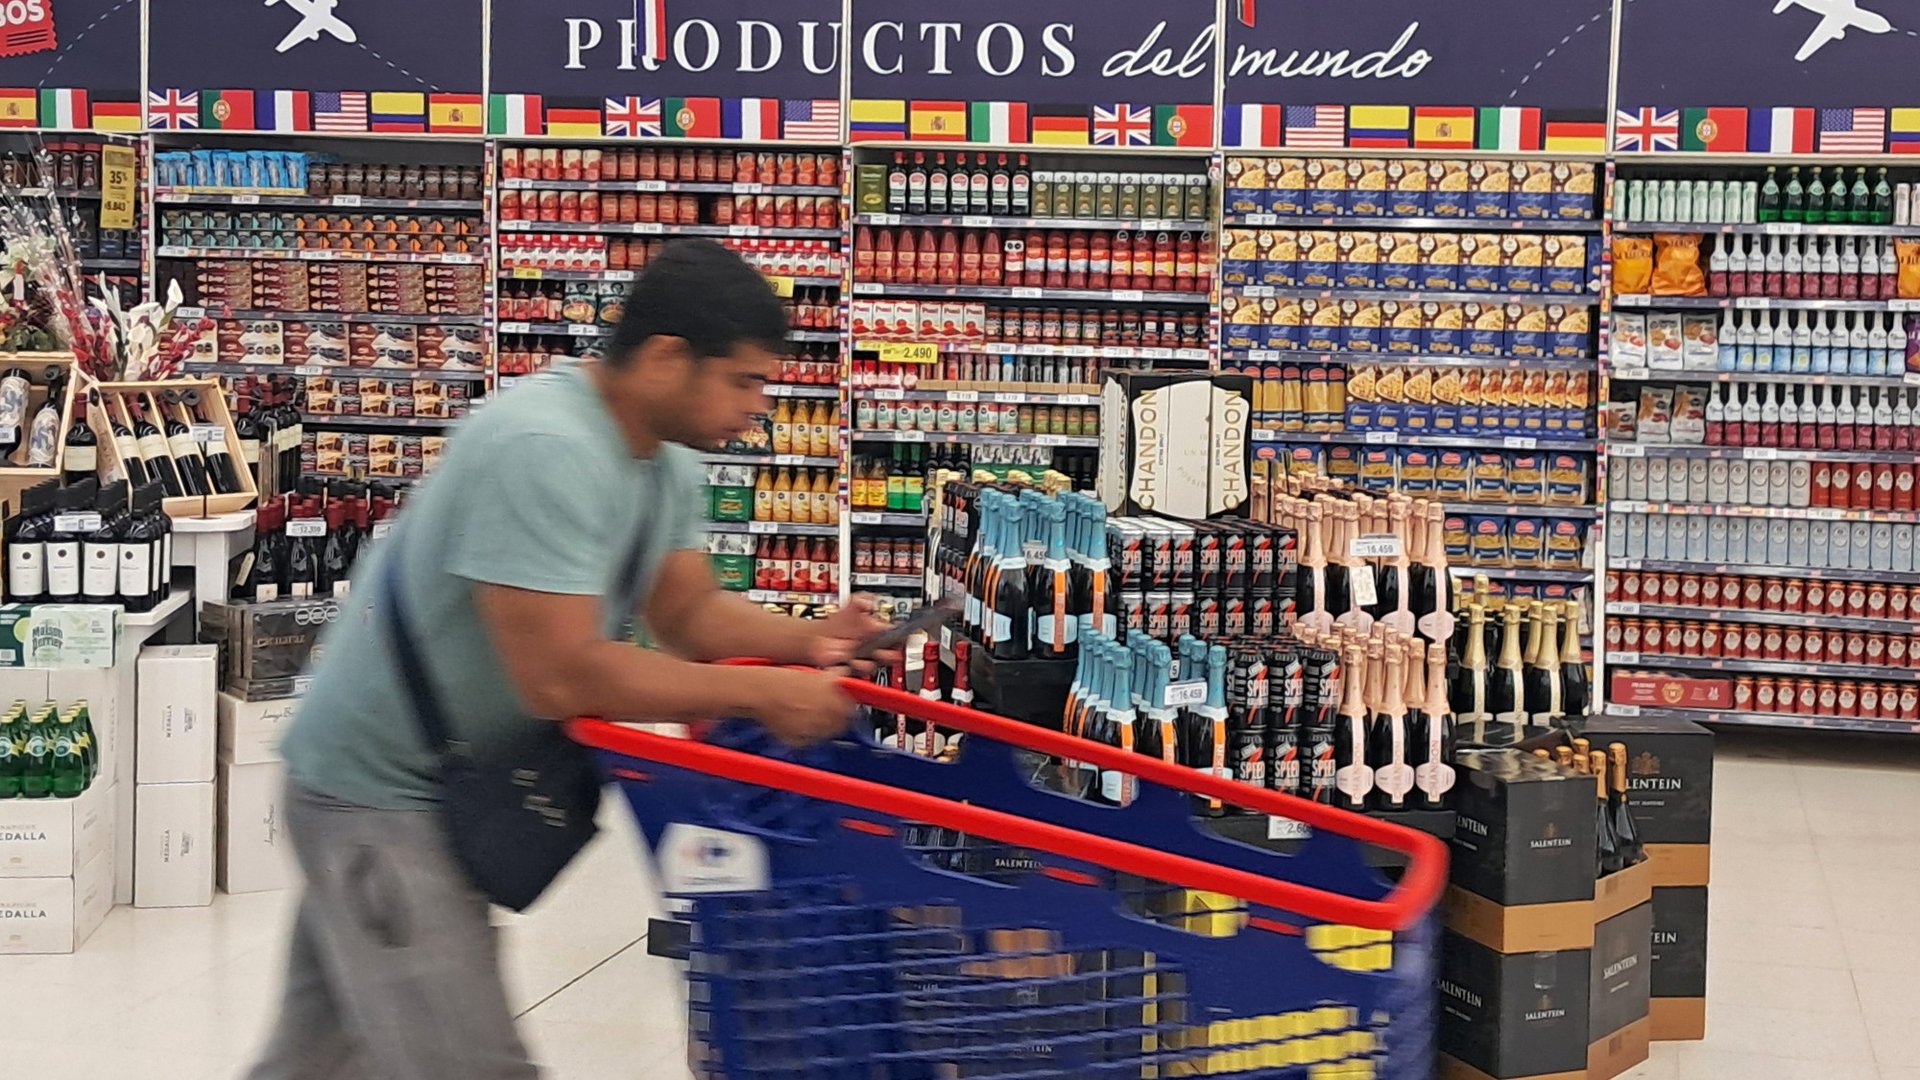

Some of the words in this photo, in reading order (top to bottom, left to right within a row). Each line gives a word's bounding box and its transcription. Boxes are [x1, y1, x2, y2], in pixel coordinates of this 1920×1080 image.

[1102, 21, 1216, 79] del
[1229, 21, 1432, 79] mundo
[903, 347, 932, 359] 2.490
[1138, 389, 1157, 511] CHANDON
[1223, 390, 1243, 511] CHANDON
[1625, 778, 1682, 790] LENTEIN
[0, 832, 47, 841] EDALLA
[1529, 837, 1572, 849] SALENTEIN
[0, 910, 47, 918] EDALLA
[1602, 953, 1638, 980] SALENTEIN
[1525, 1009, 1566, 1021] SALENTEIN
